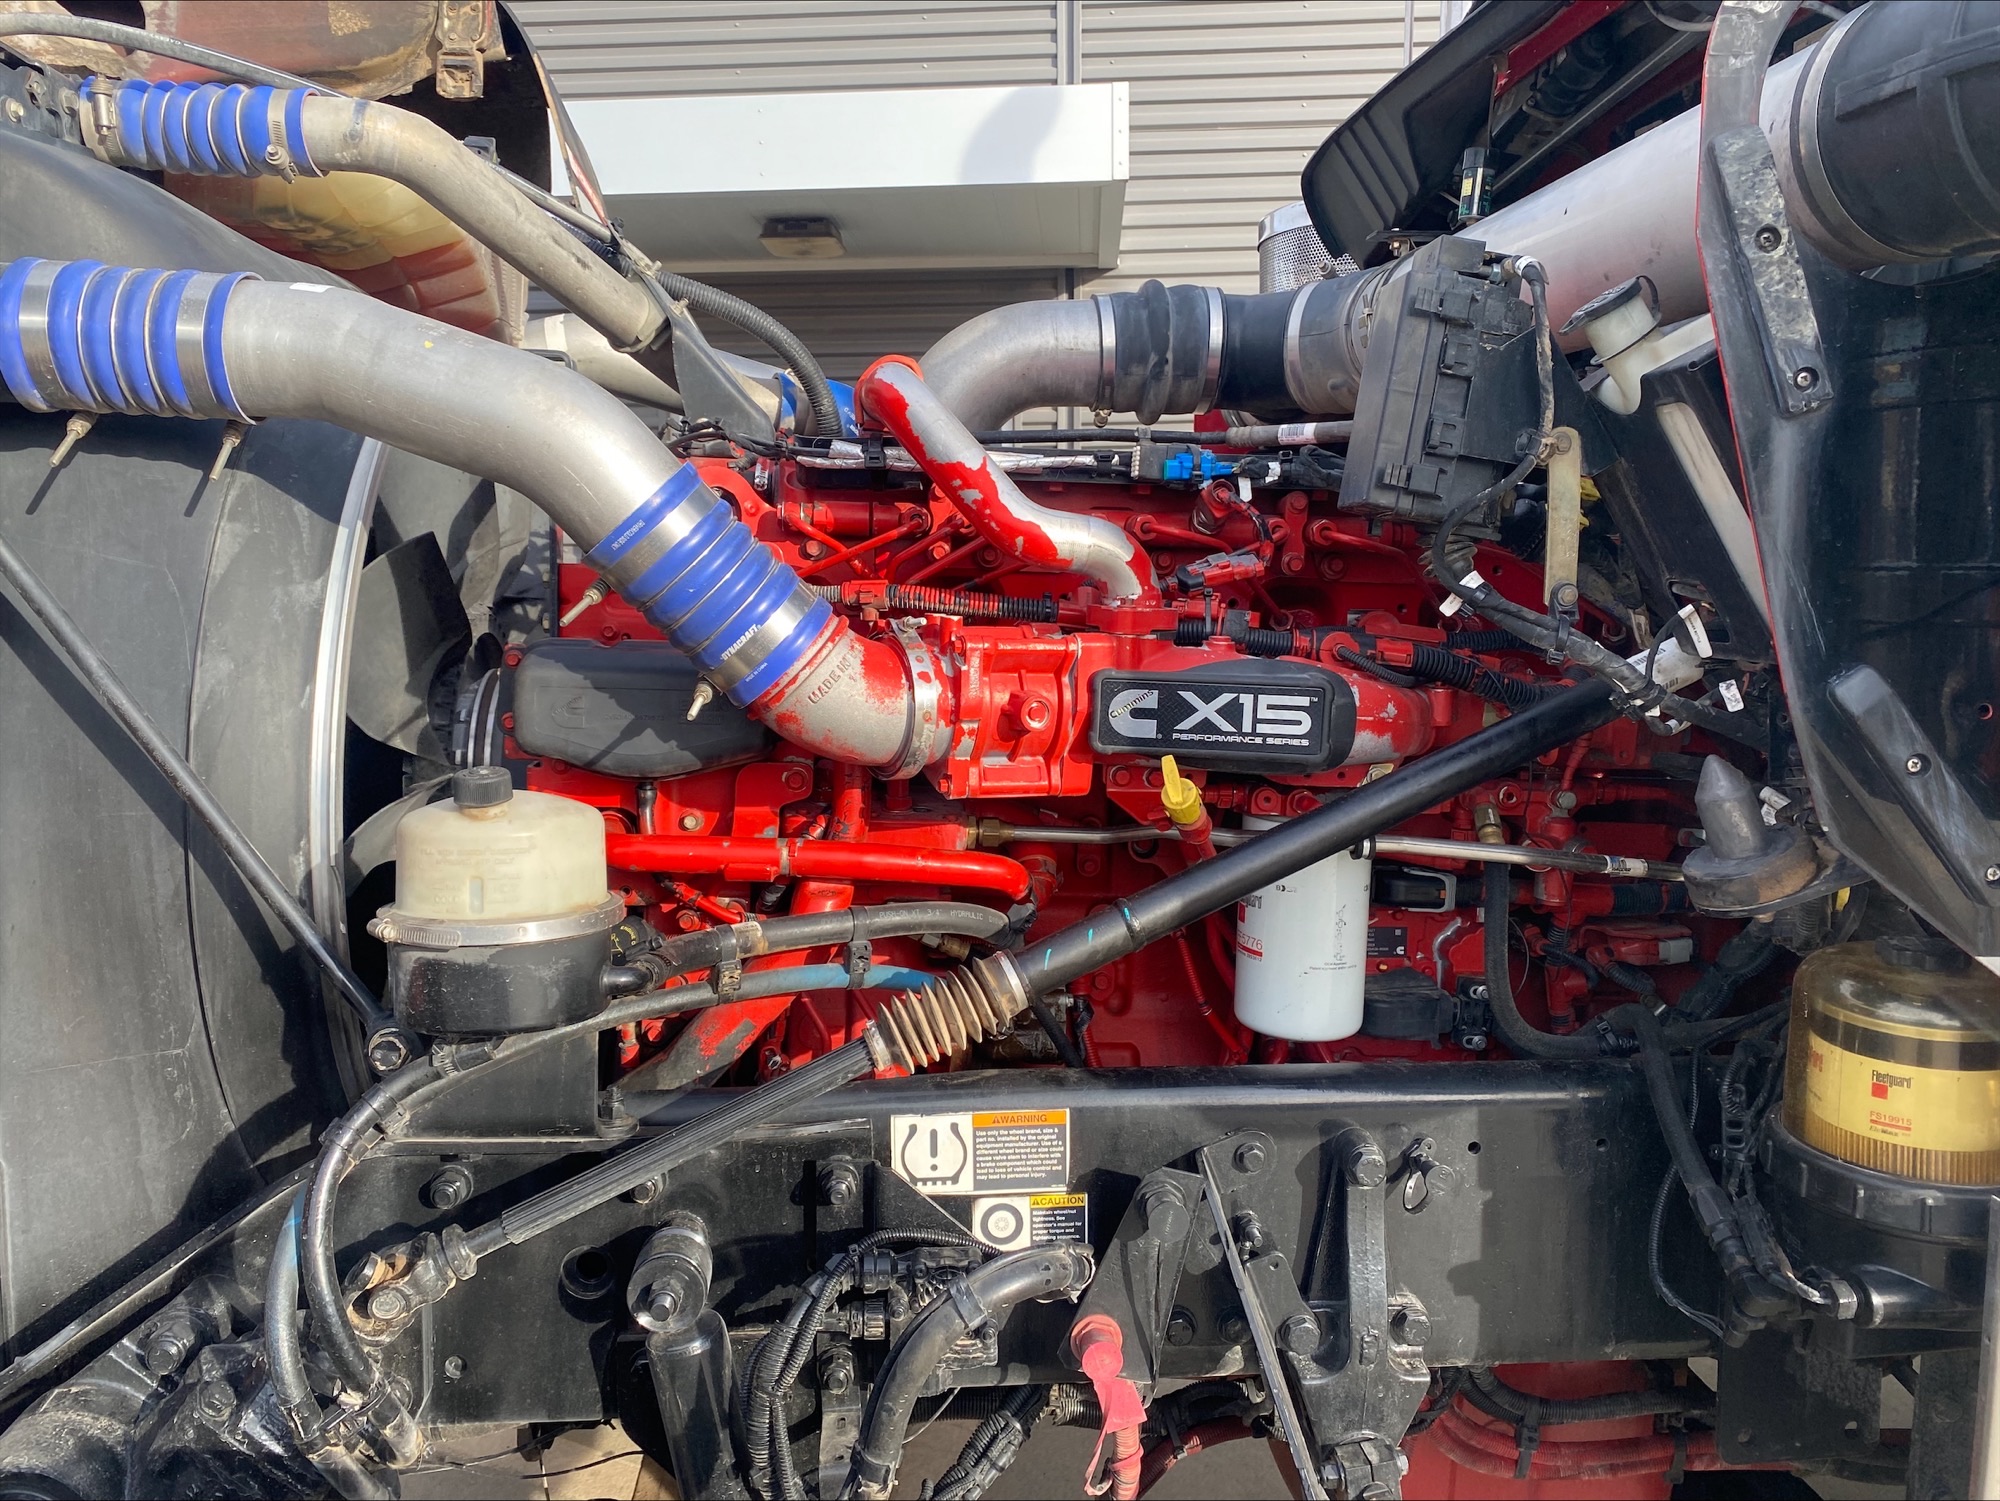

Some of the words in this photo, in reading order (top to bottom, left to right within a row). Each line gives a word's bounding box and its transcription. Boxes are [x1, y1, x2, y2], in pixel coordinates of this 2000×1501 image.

[721, 624, 758, 661] DYNACRAFT
[1173, 733, 1263, 744] PERFORMANCE
[1265, 737, 1310, 746] SERIES
[950, 909, 983, 920] HYDRAULIC
[1872, 1069, 1911, 1088] Fleetguard
[1000, 1114, 1047, 1123] WARNING
[1870, 1110, 1912, 1126] FS19915
[1040, 1196, 1084, 1205] CAUTION
